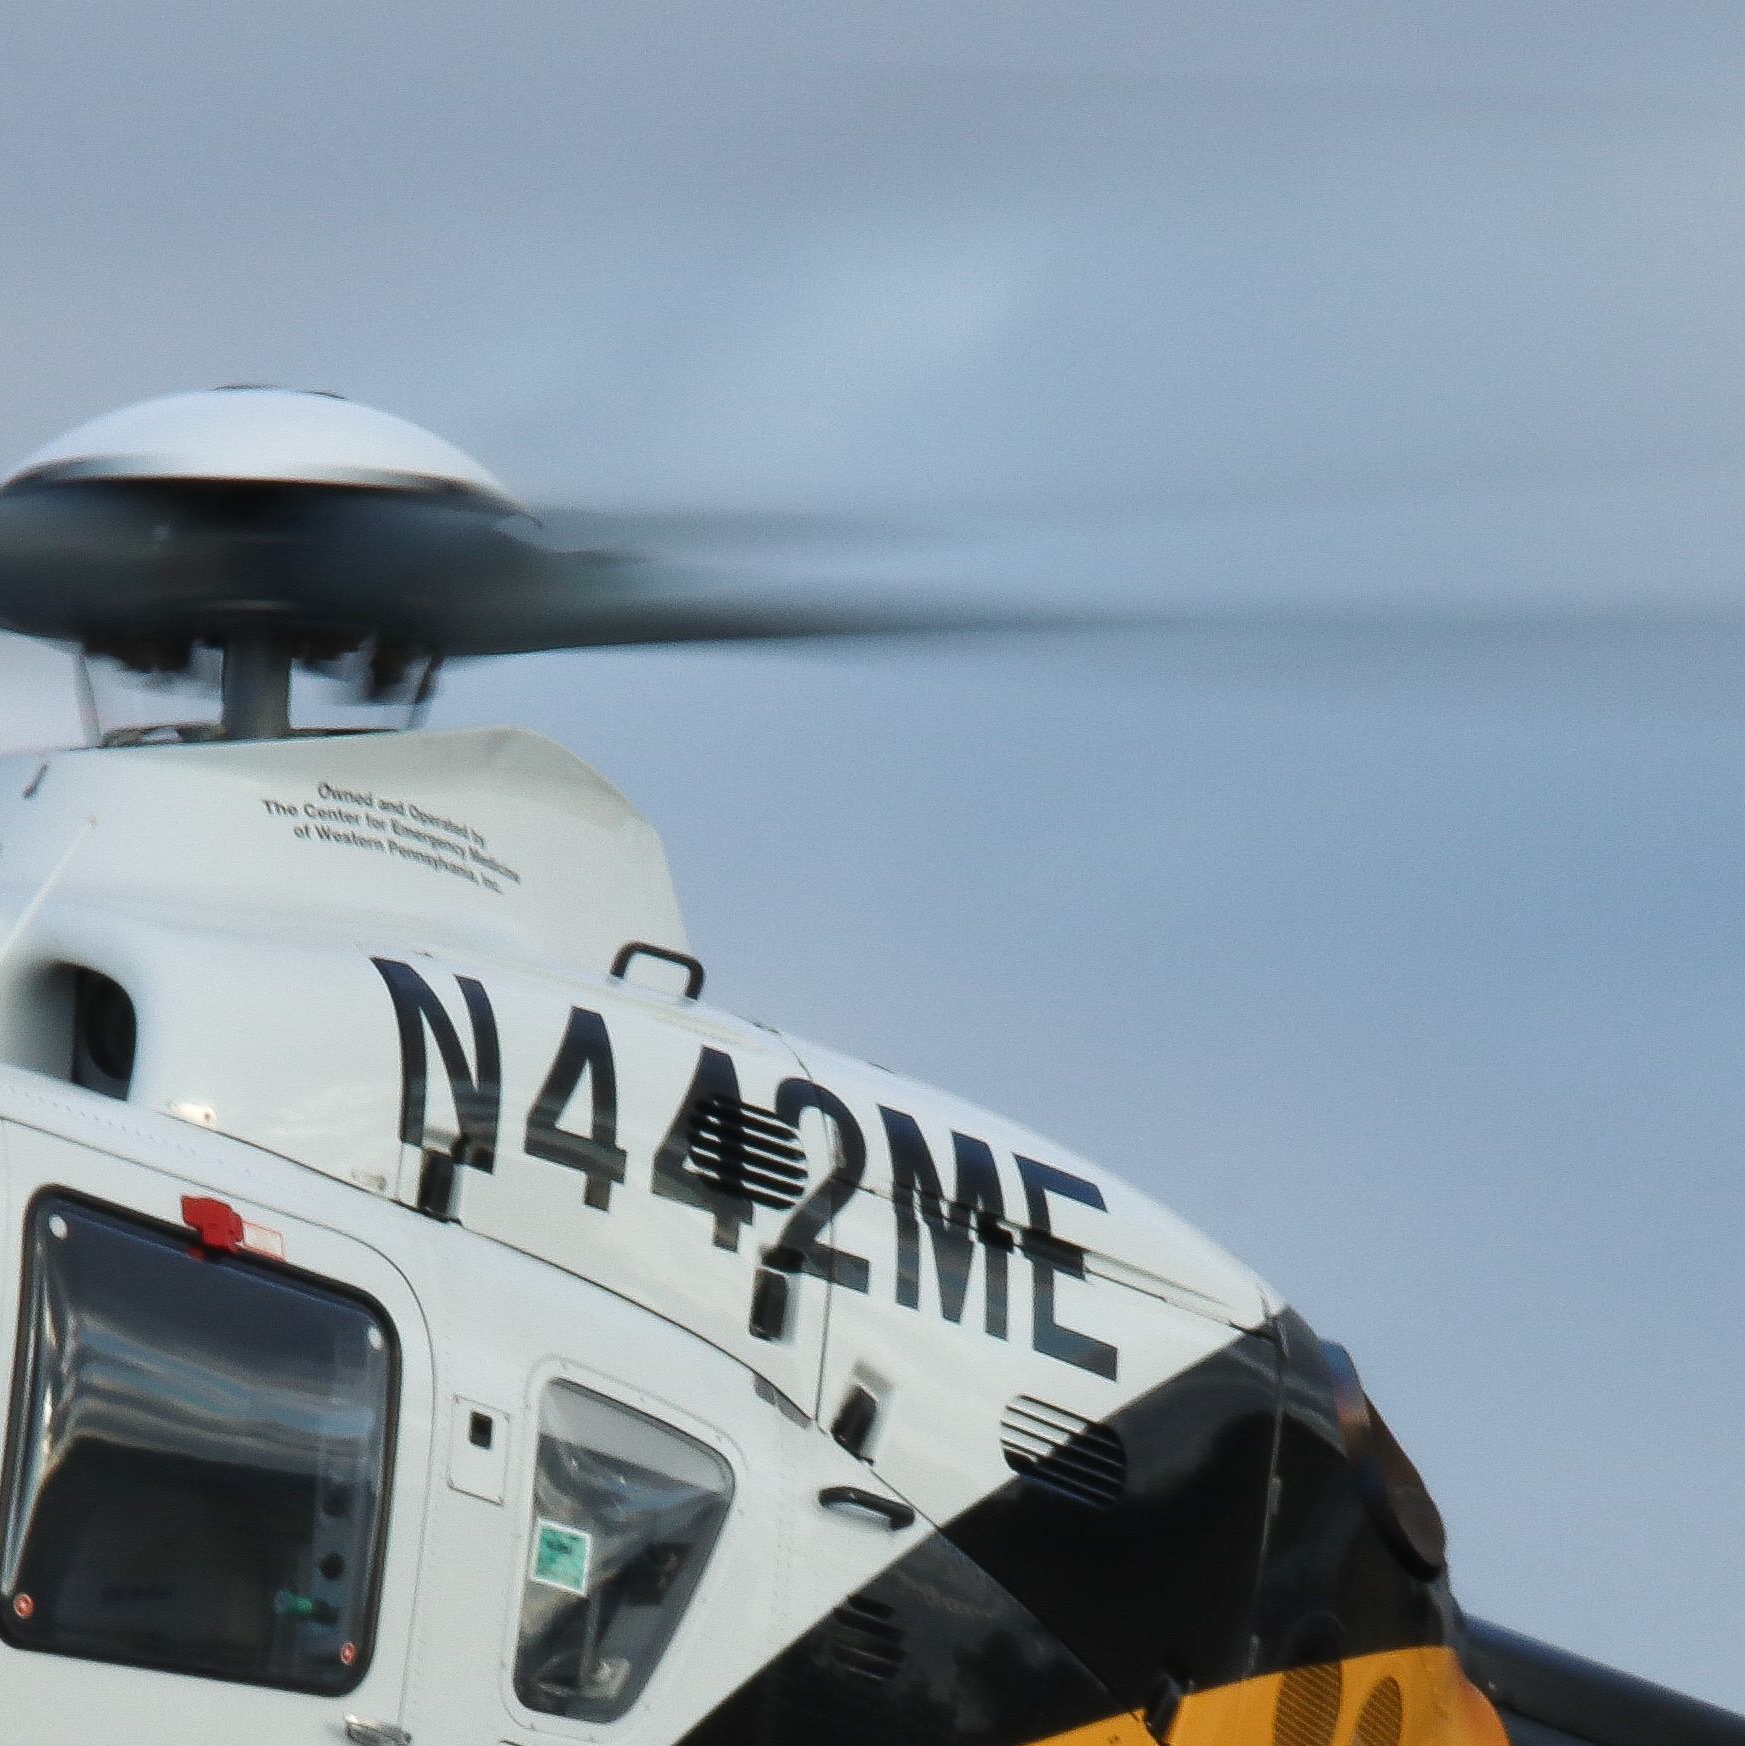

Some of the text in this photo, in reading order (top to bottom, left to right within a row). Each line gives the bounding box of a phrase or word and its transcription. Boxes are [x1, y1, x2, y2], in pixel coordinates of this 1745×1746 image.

[262, 799, 521, 885] The Center for Emergency Medicine
[293, 824, 311, 840] of
[313, 824, 385, 852] Western
[317, 780, 486, 849] Owned and Operated by
[371, 956, 1120, 1382] N442ME
